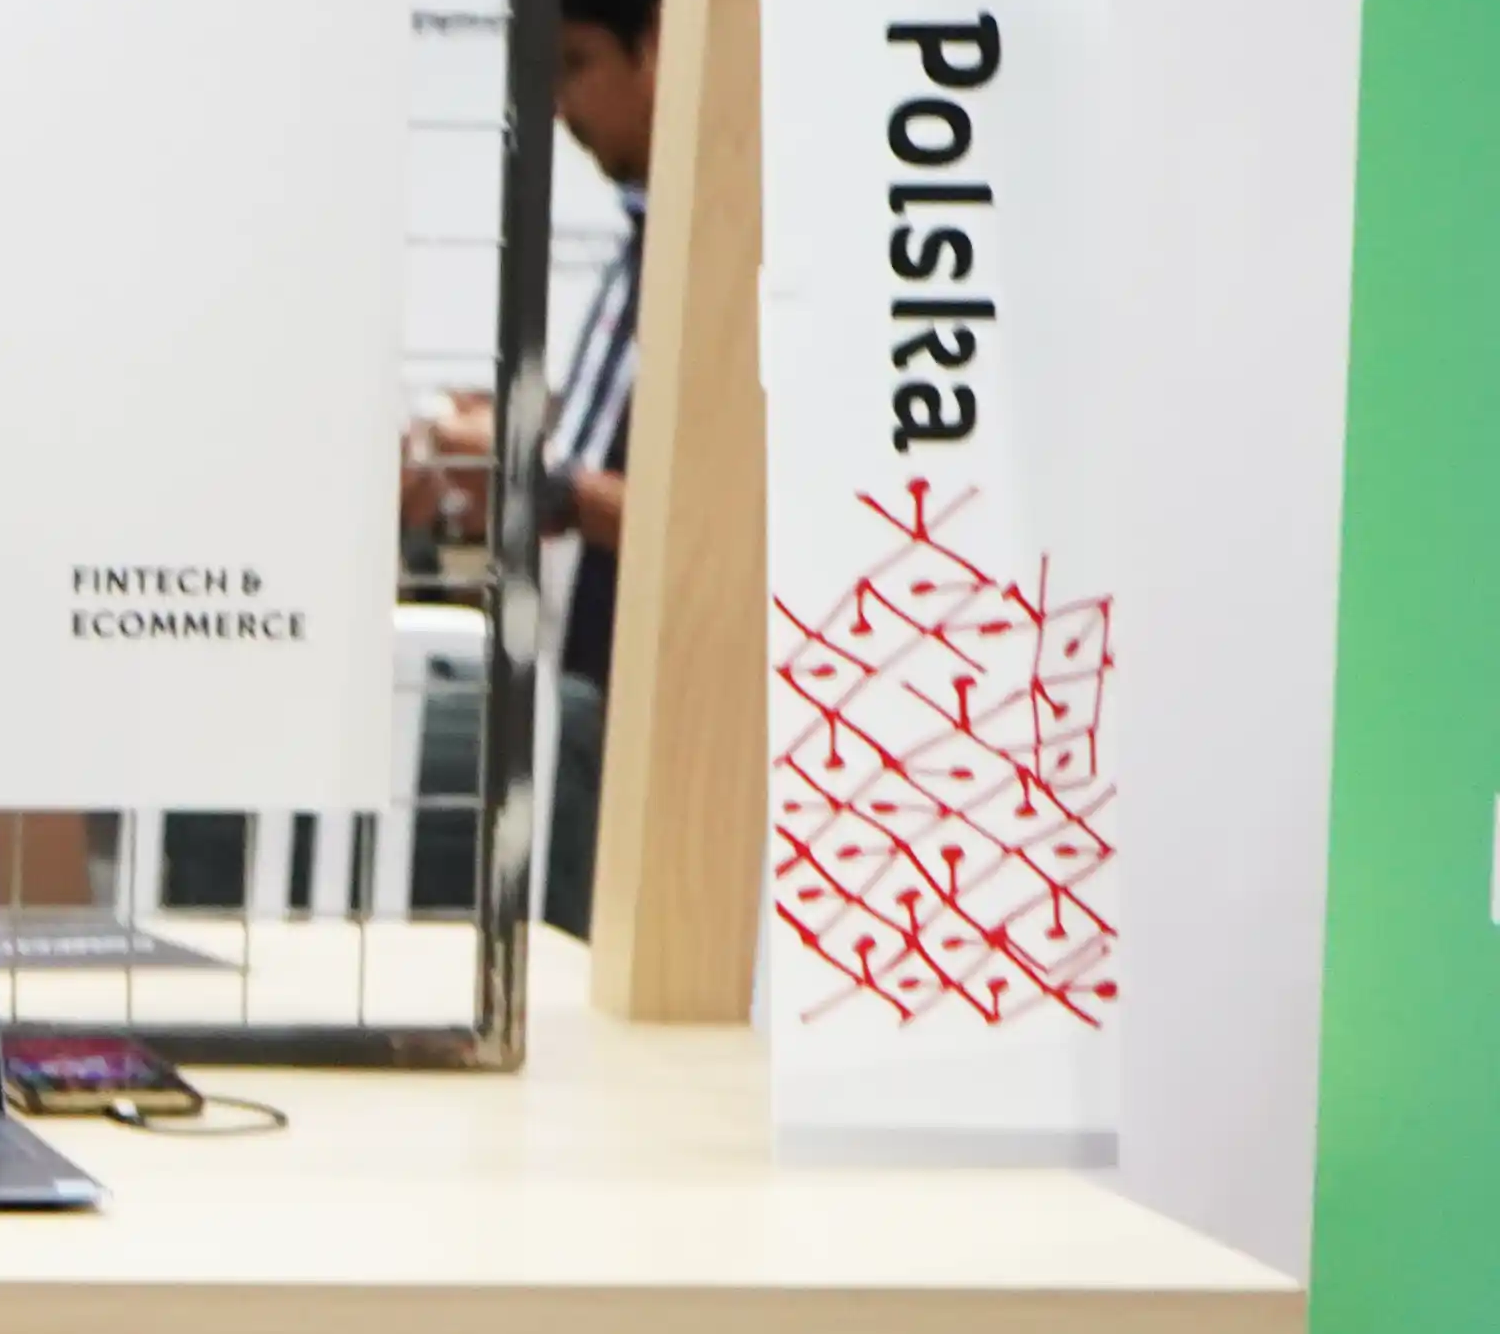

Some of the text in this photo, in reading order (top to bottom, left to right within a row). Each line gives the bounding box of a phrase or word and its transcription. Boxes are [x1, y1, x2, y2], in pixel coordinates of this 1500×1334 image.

[885, 11, 1002, 453] Polska
[73, 567, 263, 597] FINTECH &
[71, 611, 305, 640] ECOMMERCE
